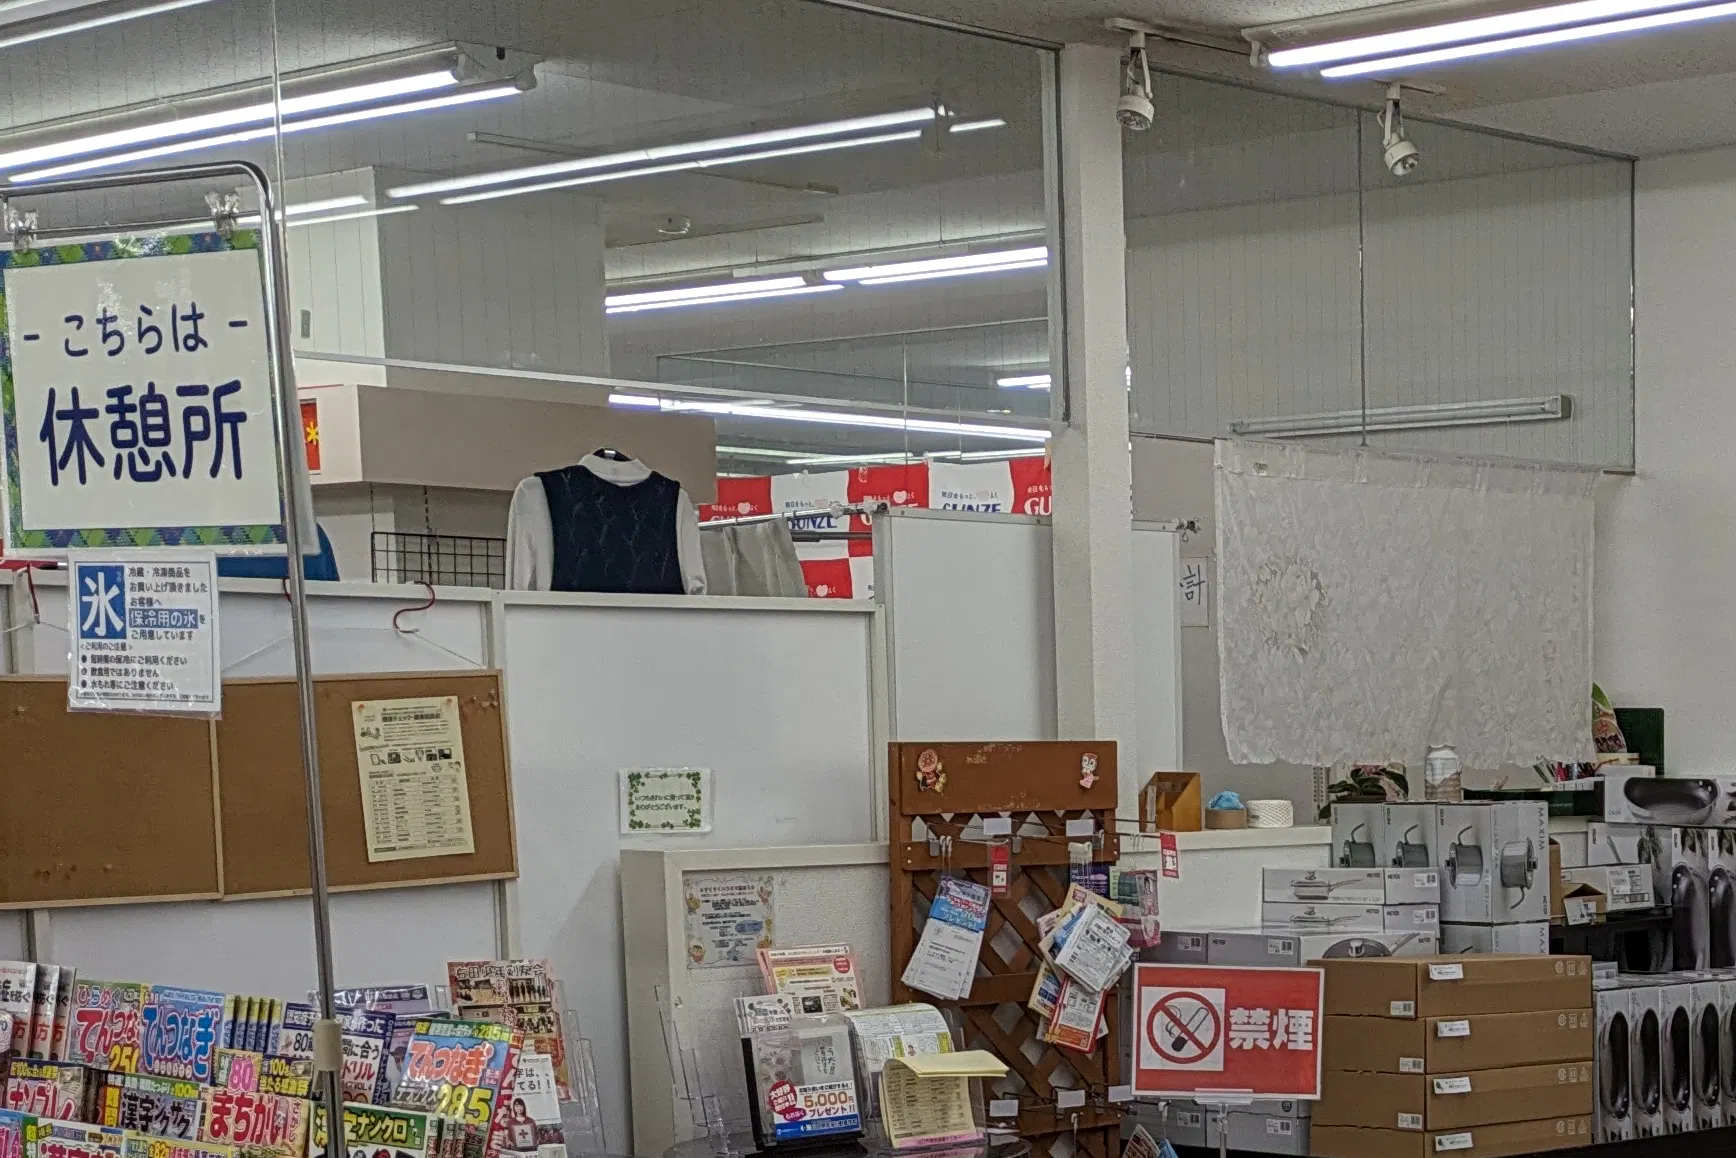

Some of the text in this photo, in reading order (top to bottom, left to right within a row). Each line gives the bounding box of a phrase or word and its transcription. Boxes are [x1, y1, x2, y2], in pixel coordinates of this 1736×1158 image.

[62, 301, 209, 357] こちらは
[39, 379, 248, 487] 休憩所
[81, 571, 125, 637] 氷
[1536, 806, 1545, 851] MAXIM
[142, 1005, 220, 1077] てんつなぎ
[1228, 1006, 1314, 1052] 禁煙
[407, 1040, 495, 1088] てんつなぎ
[120, 1091, 193, 1138] 漢字ジグザグ
[210, 1090, 290, 1146] まちがい
[436, 1083, 493, 1125] 285
